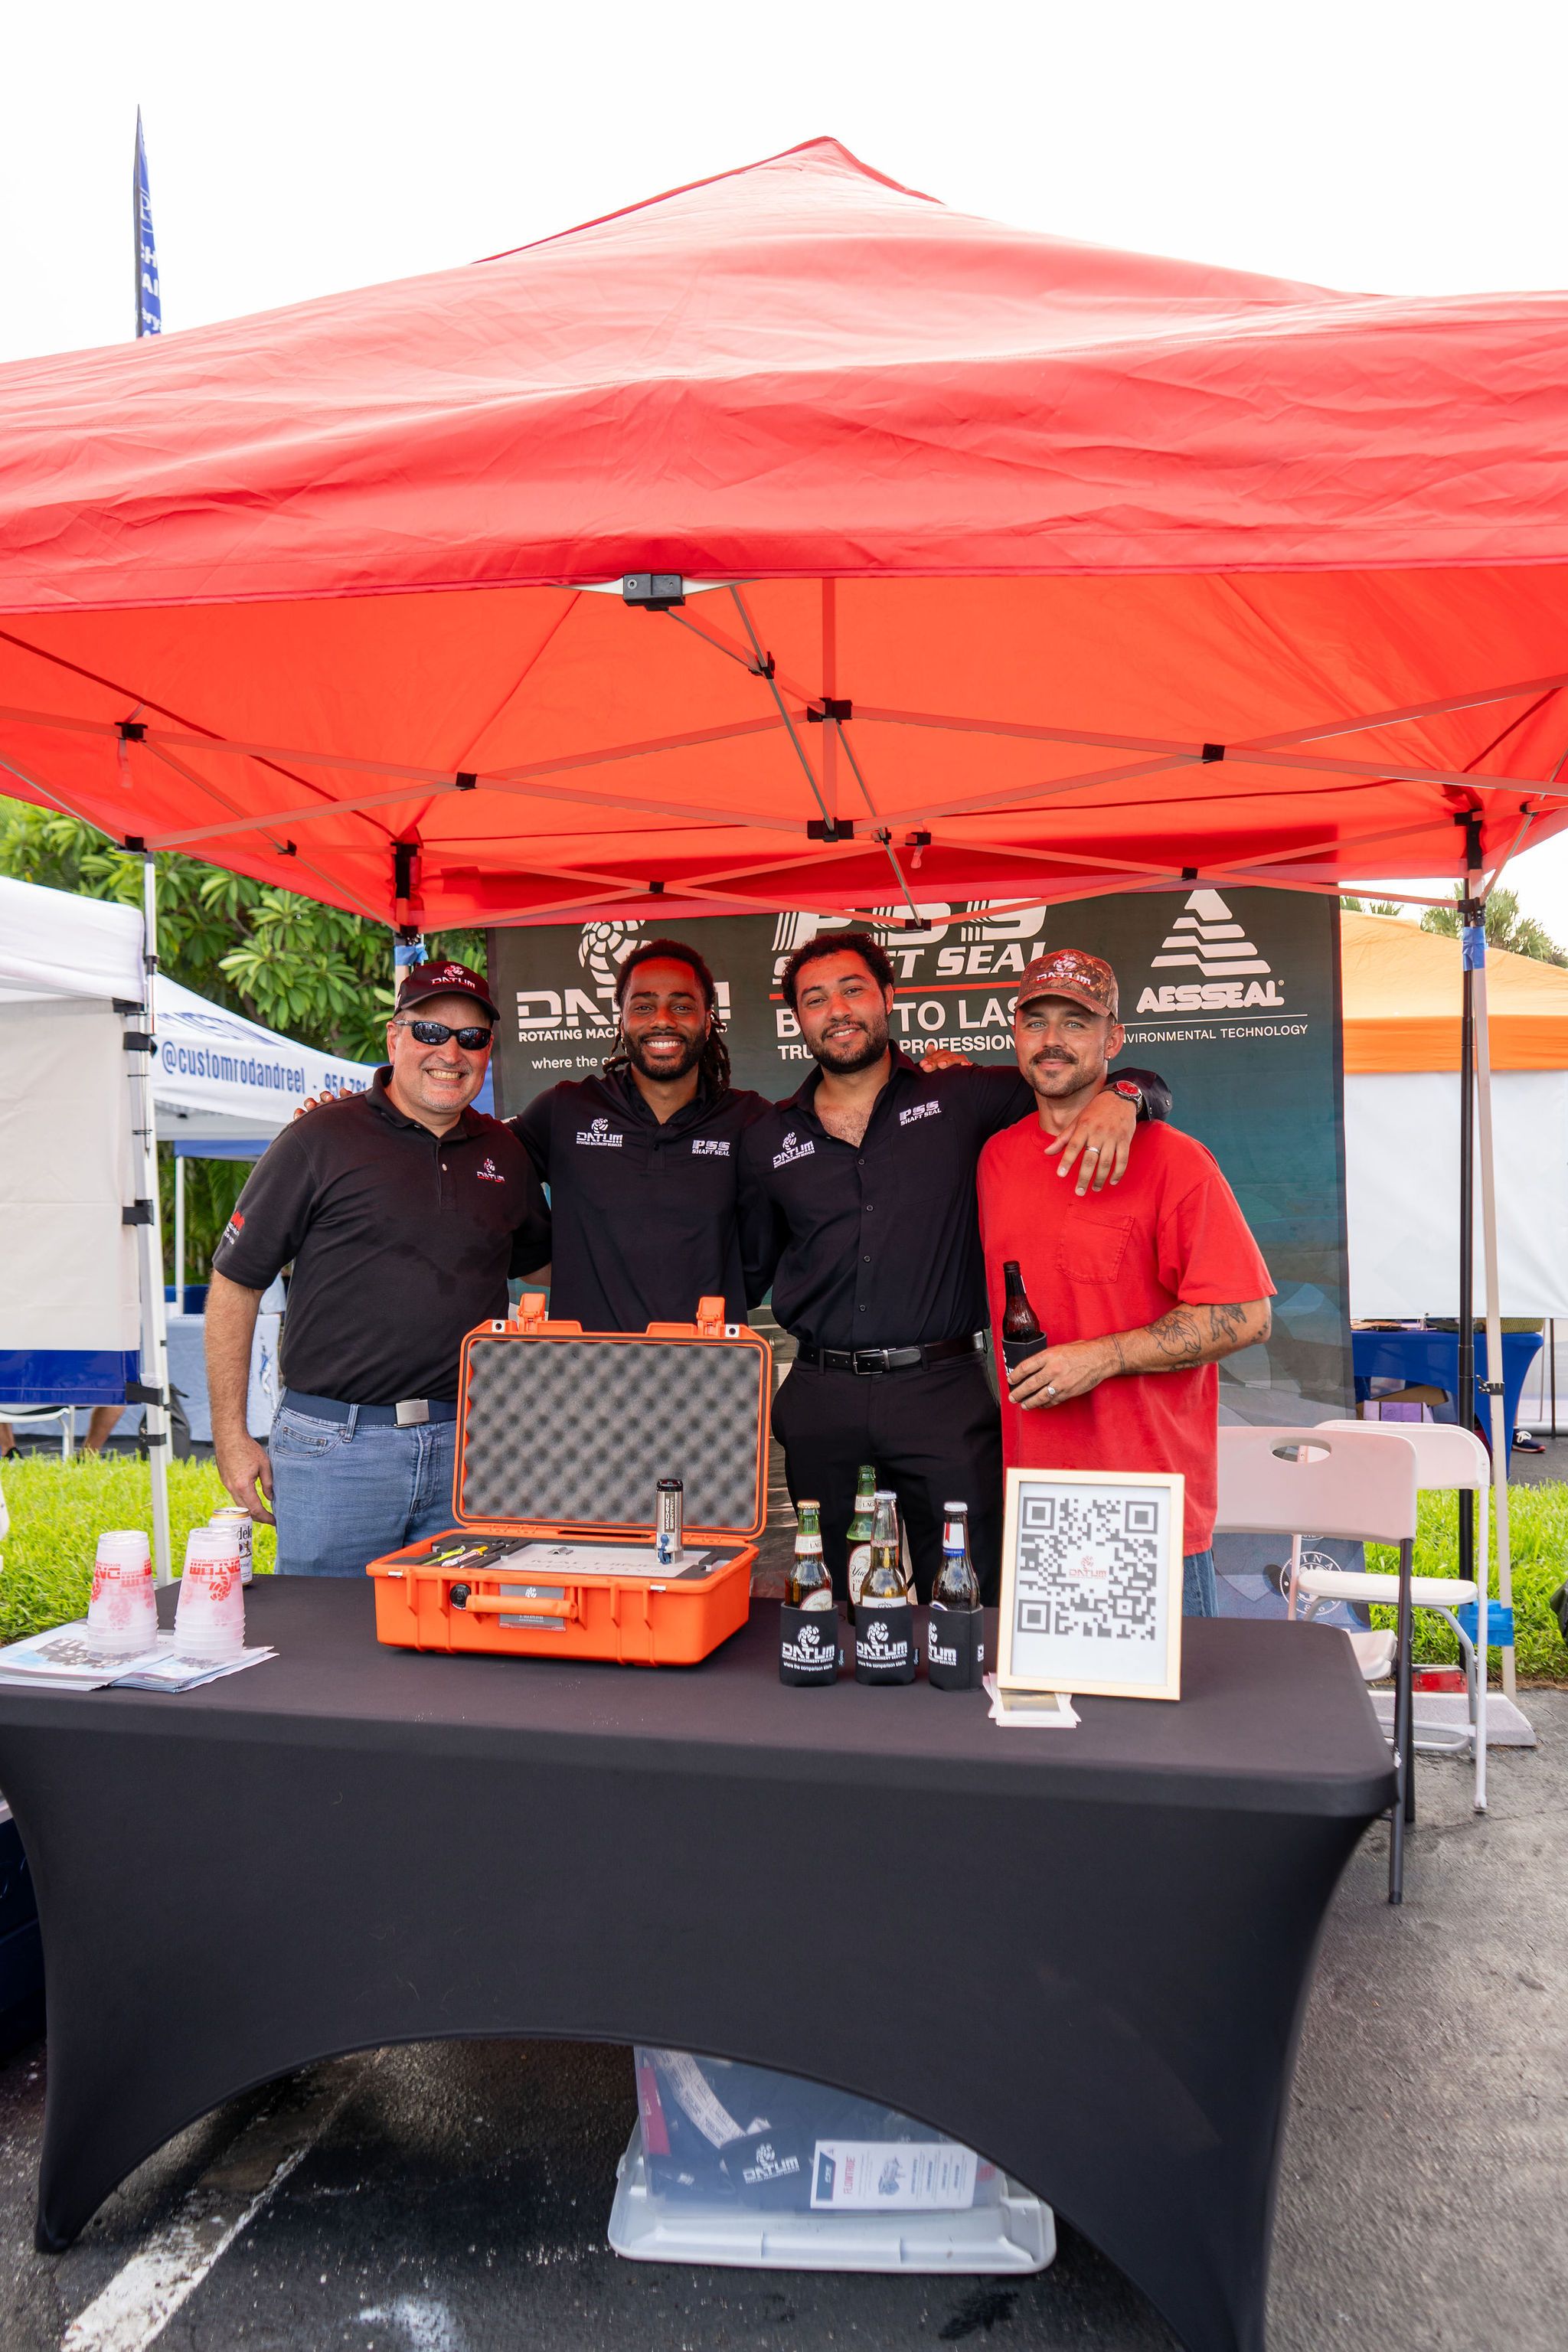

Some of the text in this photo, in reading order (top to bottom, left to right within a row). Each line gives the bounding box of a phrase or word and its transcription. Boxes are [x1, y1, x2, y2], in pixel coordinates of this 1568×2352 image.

[430, 976, 475, 990] DATUM
[1136, 980, 1285, 1014] AESSEAL
[891, 995, 1017, 1033] TO LA
[518, 1029, 583, 1043] ROTATING
[1122, 1024, 1308, 1044] NVIRONMENTAL TECHNOLOGY
[900, 1034, 1017, 1054] PROFESSION
[162, 1040, 306, 1095] @customrodandreel
[531, 1056, 573, 1070] where
[576, 1055, 599, 1067] the
[899, 1100, 939, 1122] PSS
[900, 1108, 942, 1126] SHAFT SEAL
[577, 1132, 623, 1144] DATUM
[692, 1139, 730, 1151] PSS
[773, 1141, 815, 1165] DATUM
[1069, 1569, 1107, 1578] DATUM
[782, 1642, 835, 1659] DATUM
[856, 1641, 908, 1657] DATUM
[928, 1645, 956, 1661] TUM
